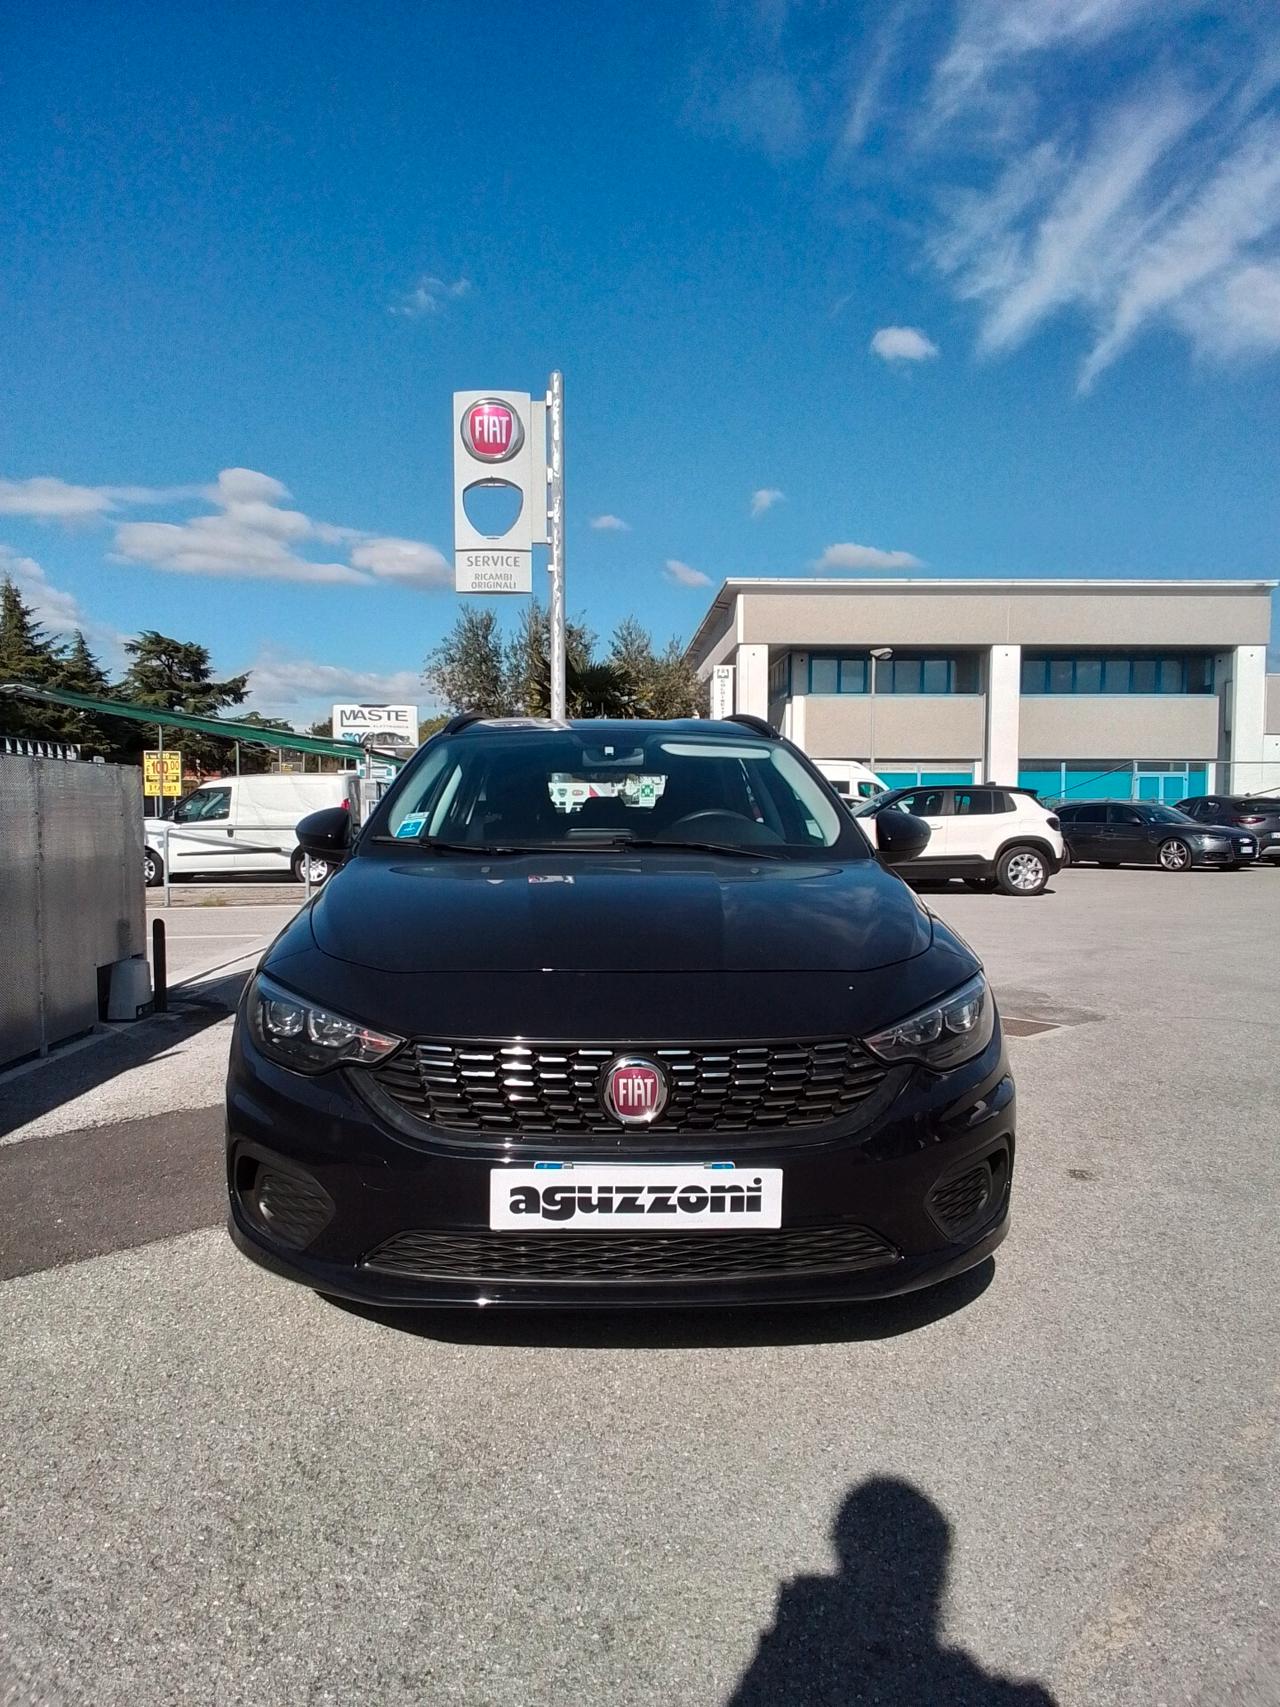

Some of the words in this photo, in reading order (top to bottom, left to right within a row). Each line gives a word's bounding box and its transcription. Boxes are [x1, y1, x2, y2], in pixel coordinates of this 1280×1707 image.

[474, 414, 509, 443] FIAT
[466, 556, 521, 568] SERVICE
[471, 581, 517, 590] ORIGINALI
[474, 573, 513, 582] RICAMBI
[340, 709, 408, 727] MASTE
[618, 1074, 655, 1107] FIAT
[509, 1177, 763, 1221] aguzzoni
